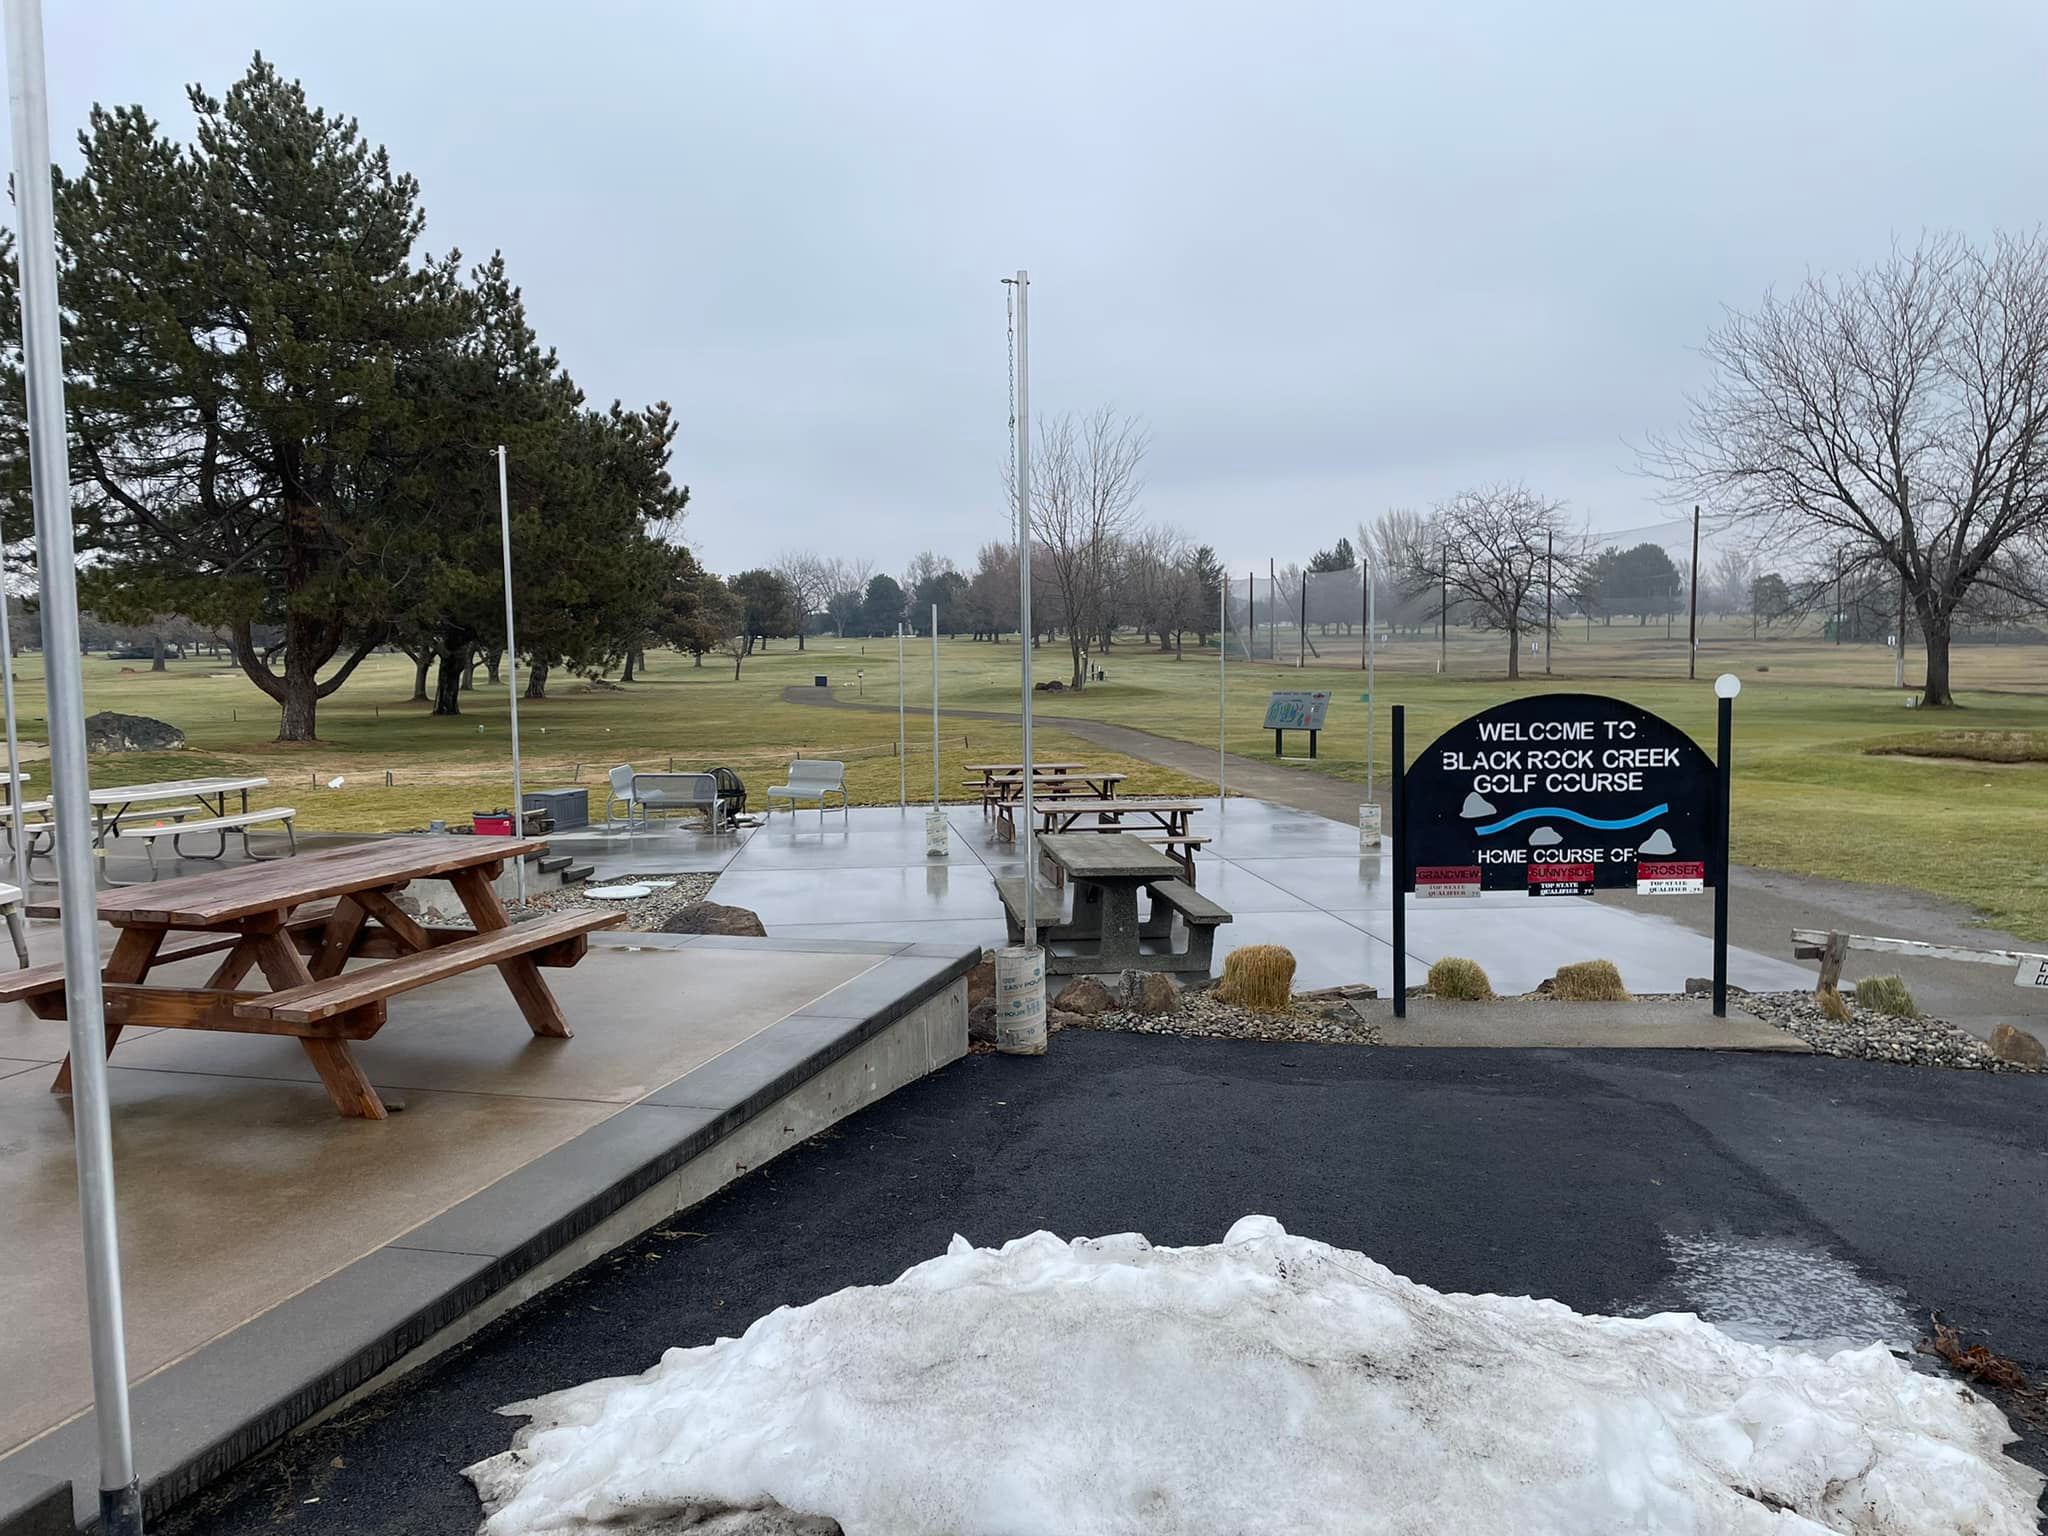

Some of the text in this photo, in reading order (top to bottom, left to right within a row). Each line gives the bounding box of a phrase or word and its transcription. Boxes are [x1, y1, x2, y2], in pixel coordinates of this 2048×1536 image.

[1479, 720, 1636, 741] WELCOME TO
[1443, 747, 1680, 771] BLACK ROCK CREEK
[1473, 772, 1643, 793] GOLF COURSE
[1478, 848, 1638, 864] HOME COURSE OF:
[1530, 867, 1591, 878] SUNNYSIDE
[1642, 864, 1700, 876] PROSSER
